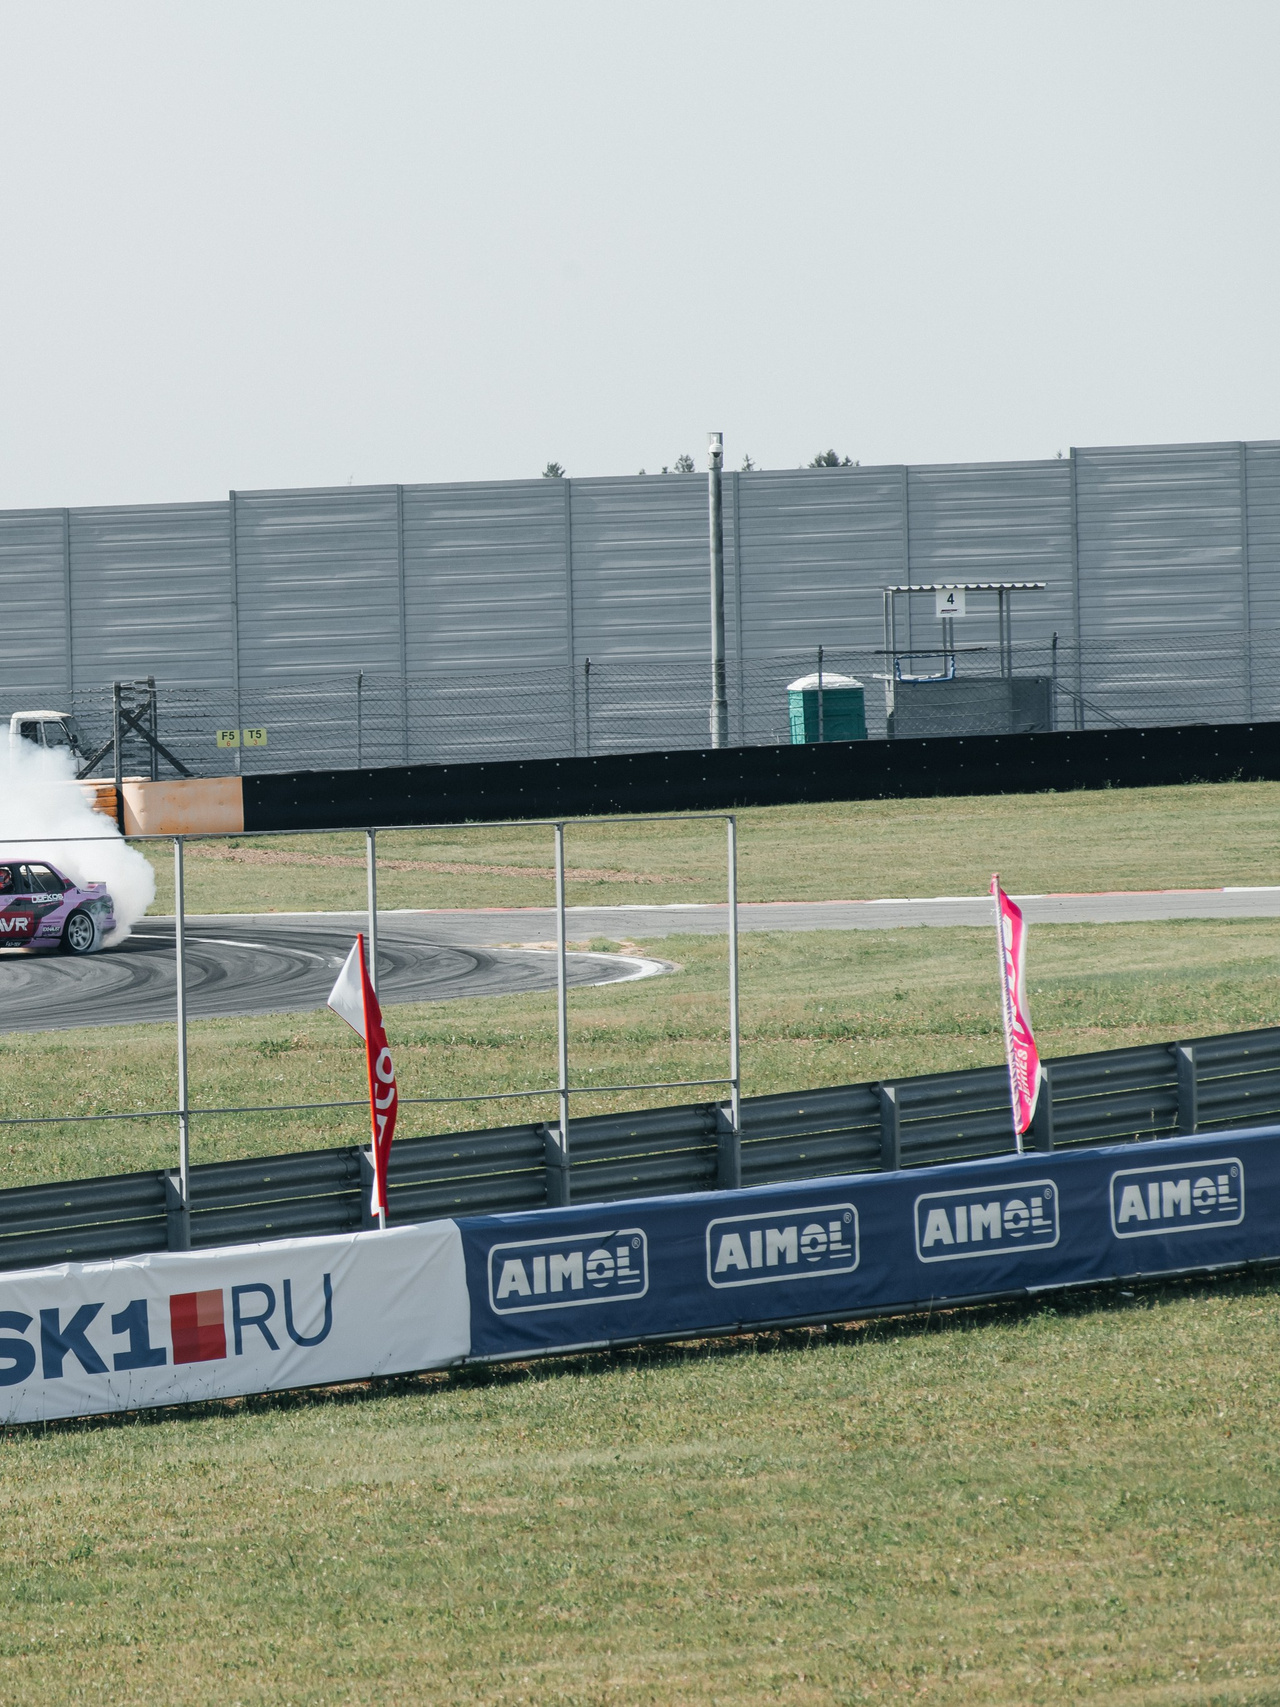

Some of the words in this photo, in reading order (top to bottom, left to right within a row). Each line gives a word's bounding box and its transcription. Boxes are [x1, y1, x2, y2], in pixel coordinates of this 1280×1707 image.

[946, 593, 955, 604] 4
[221, 731, 235, 740] F5
[247, 730, 262, 739] T5
[922, 1197, 1053, 1247] AIMOL
[1118, 1174, 1238, 1223] AIMOL
[714, 1220, 852, 1273] AIMOL
[496, 1246, 641, 1299] AIMOL
